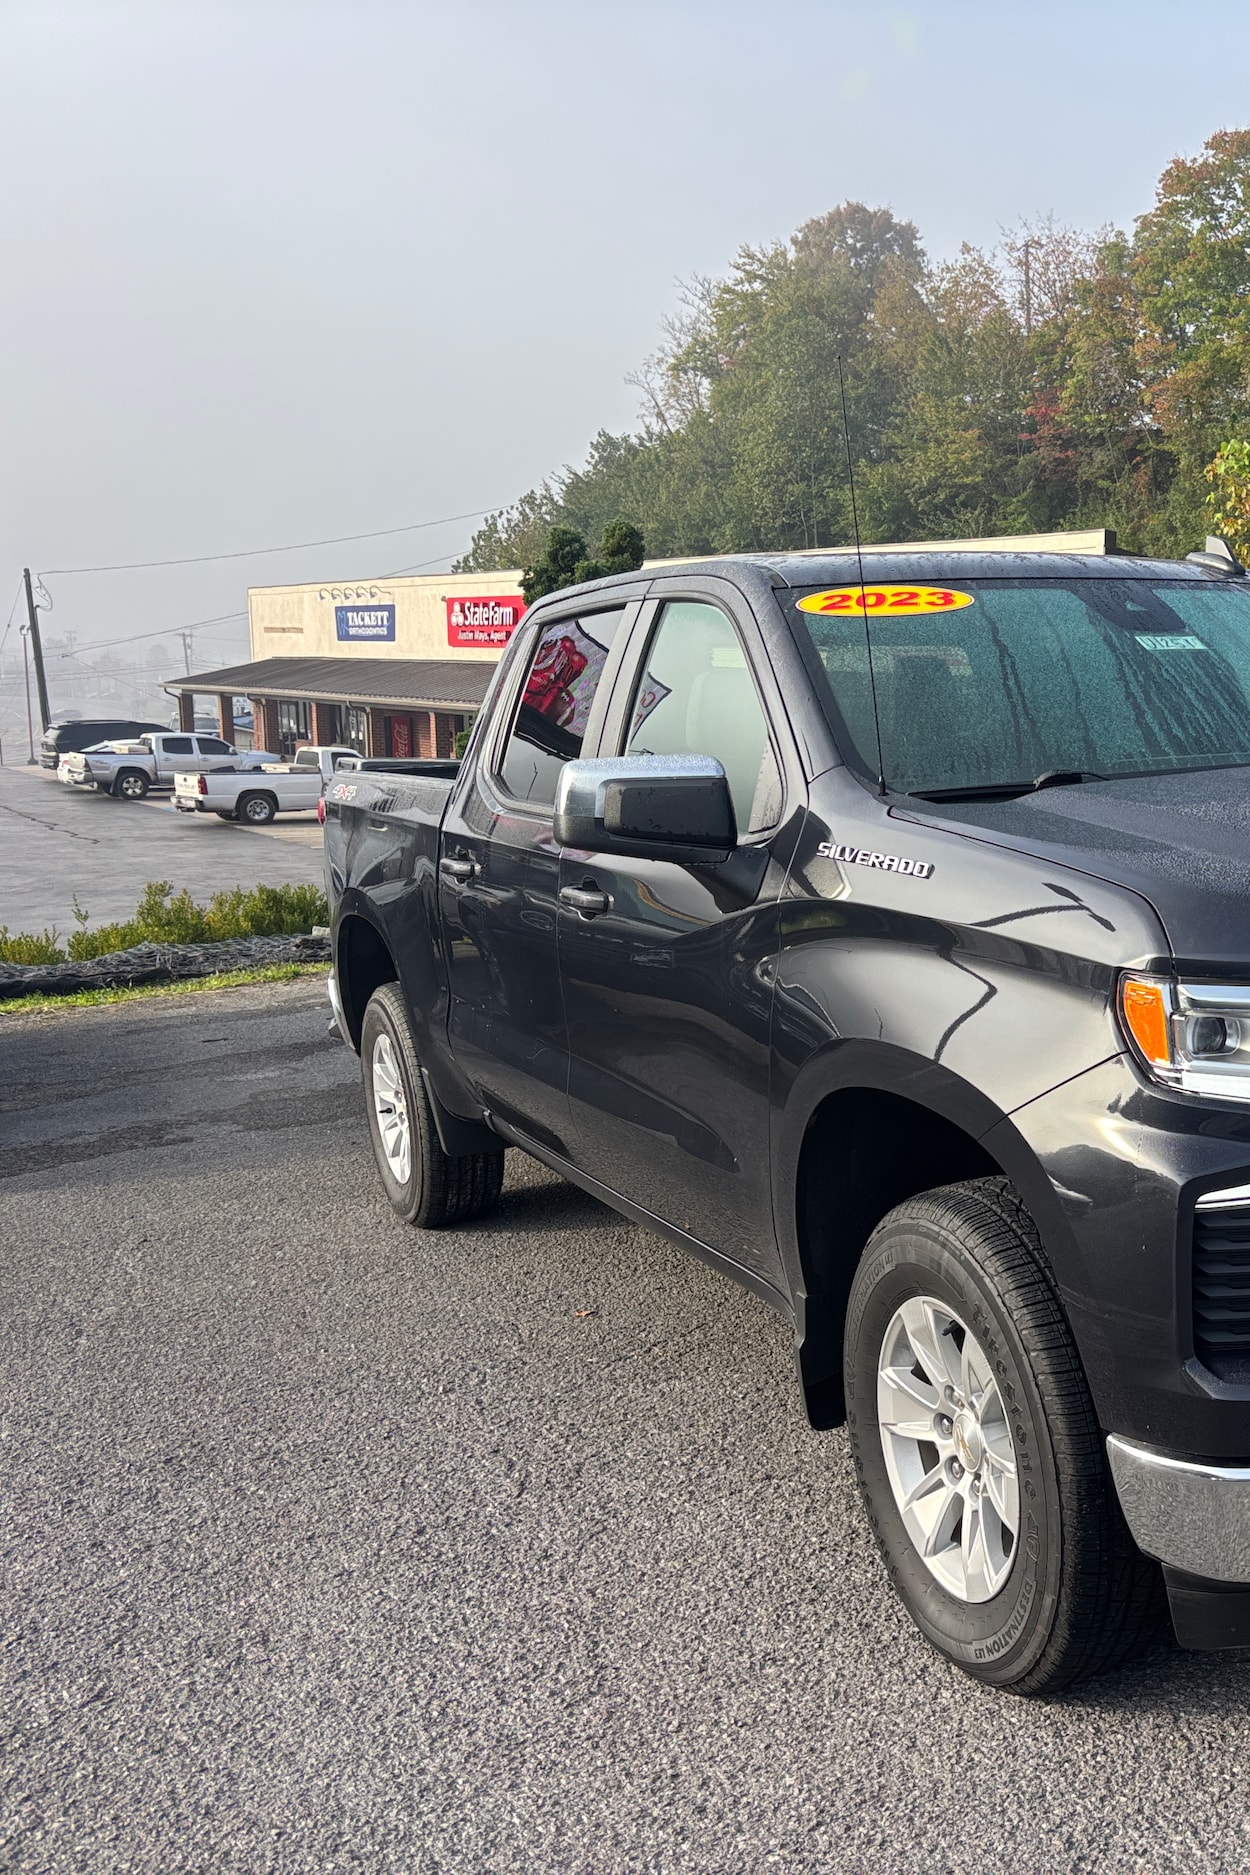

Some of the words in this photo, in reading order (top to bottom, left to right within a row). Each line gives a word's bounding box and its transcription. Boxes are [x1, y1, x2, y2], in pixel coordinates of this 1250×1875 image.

[819, 592, 956, 611] 2023
[347, 611, 389, 626] TACKETT
[348, 627, 388, 636] ORTHODONTICS
[458, 630, 474, 640] Justin
[490, 630, 506, 642] Agent
[816, 841, 931, 878] SILVERADO
[985, 1577, 1033, 1658] DESTINATION
